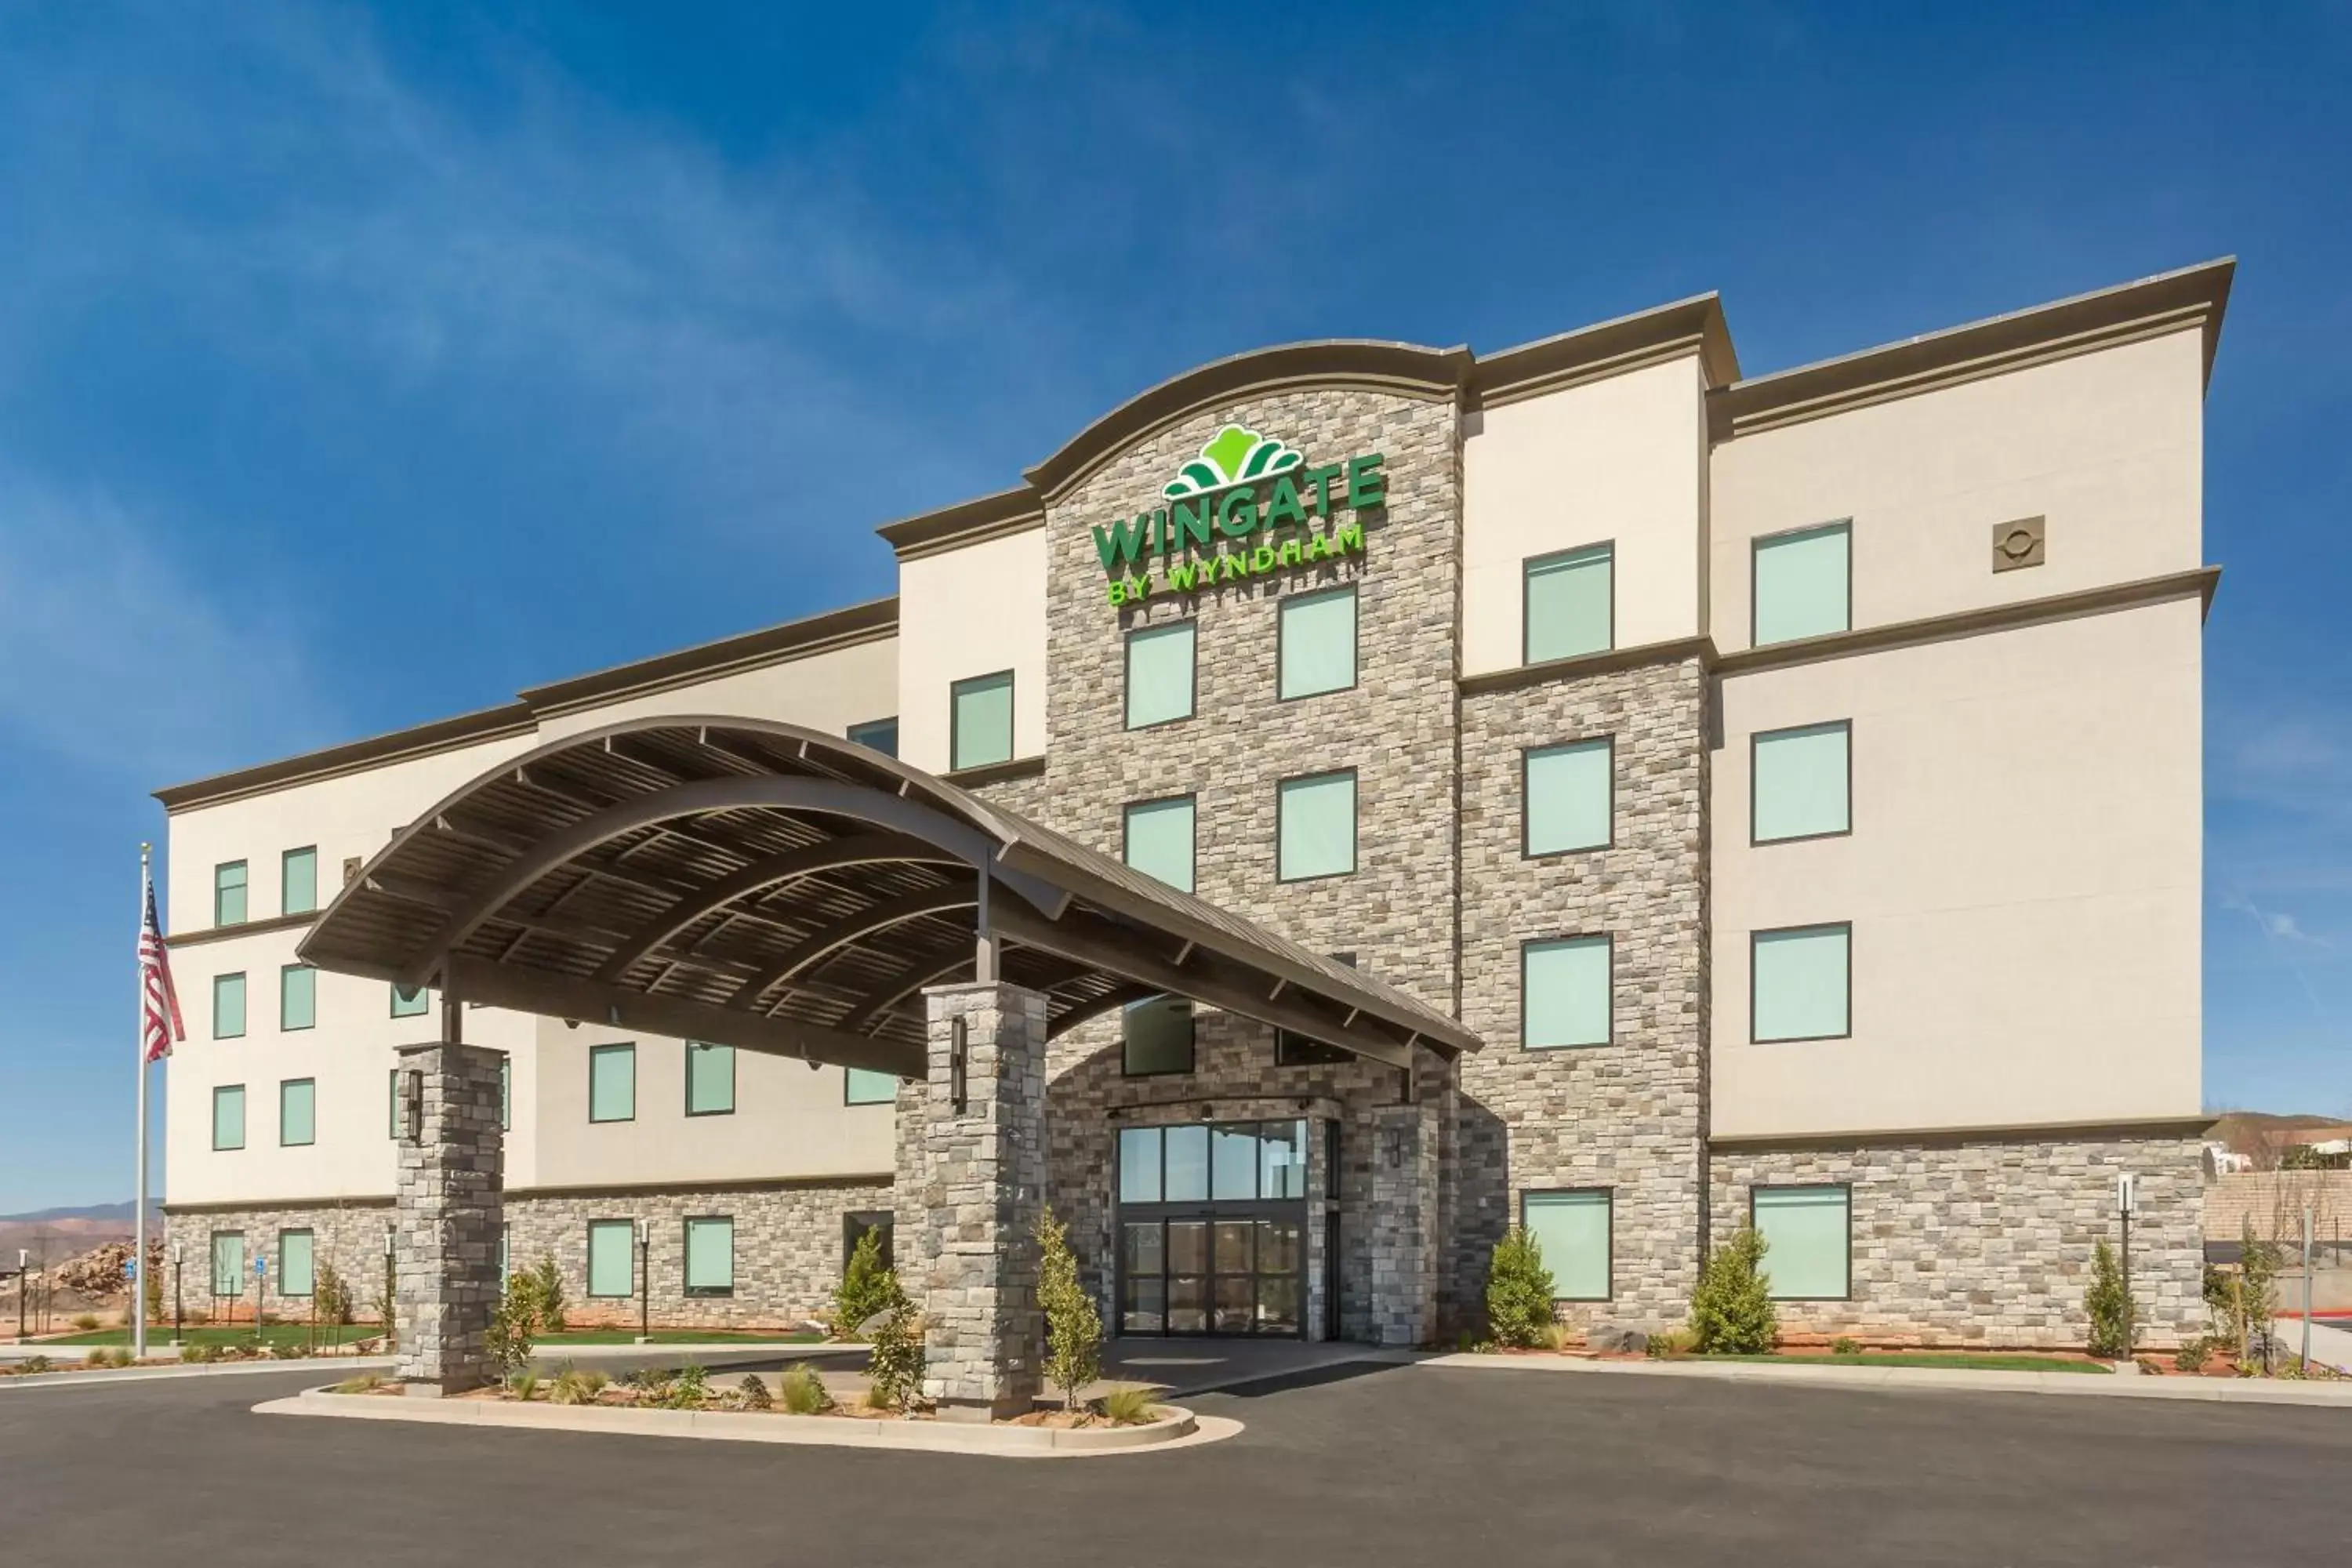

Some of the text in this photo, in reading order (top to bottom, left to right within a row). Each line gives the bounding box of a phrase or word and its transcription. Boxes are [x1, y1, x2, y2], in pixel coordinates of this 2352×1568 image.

[1091, 452, 1385, 569] WINGATE
[1108, 524, 1364, 606] BY WYNDHAM
